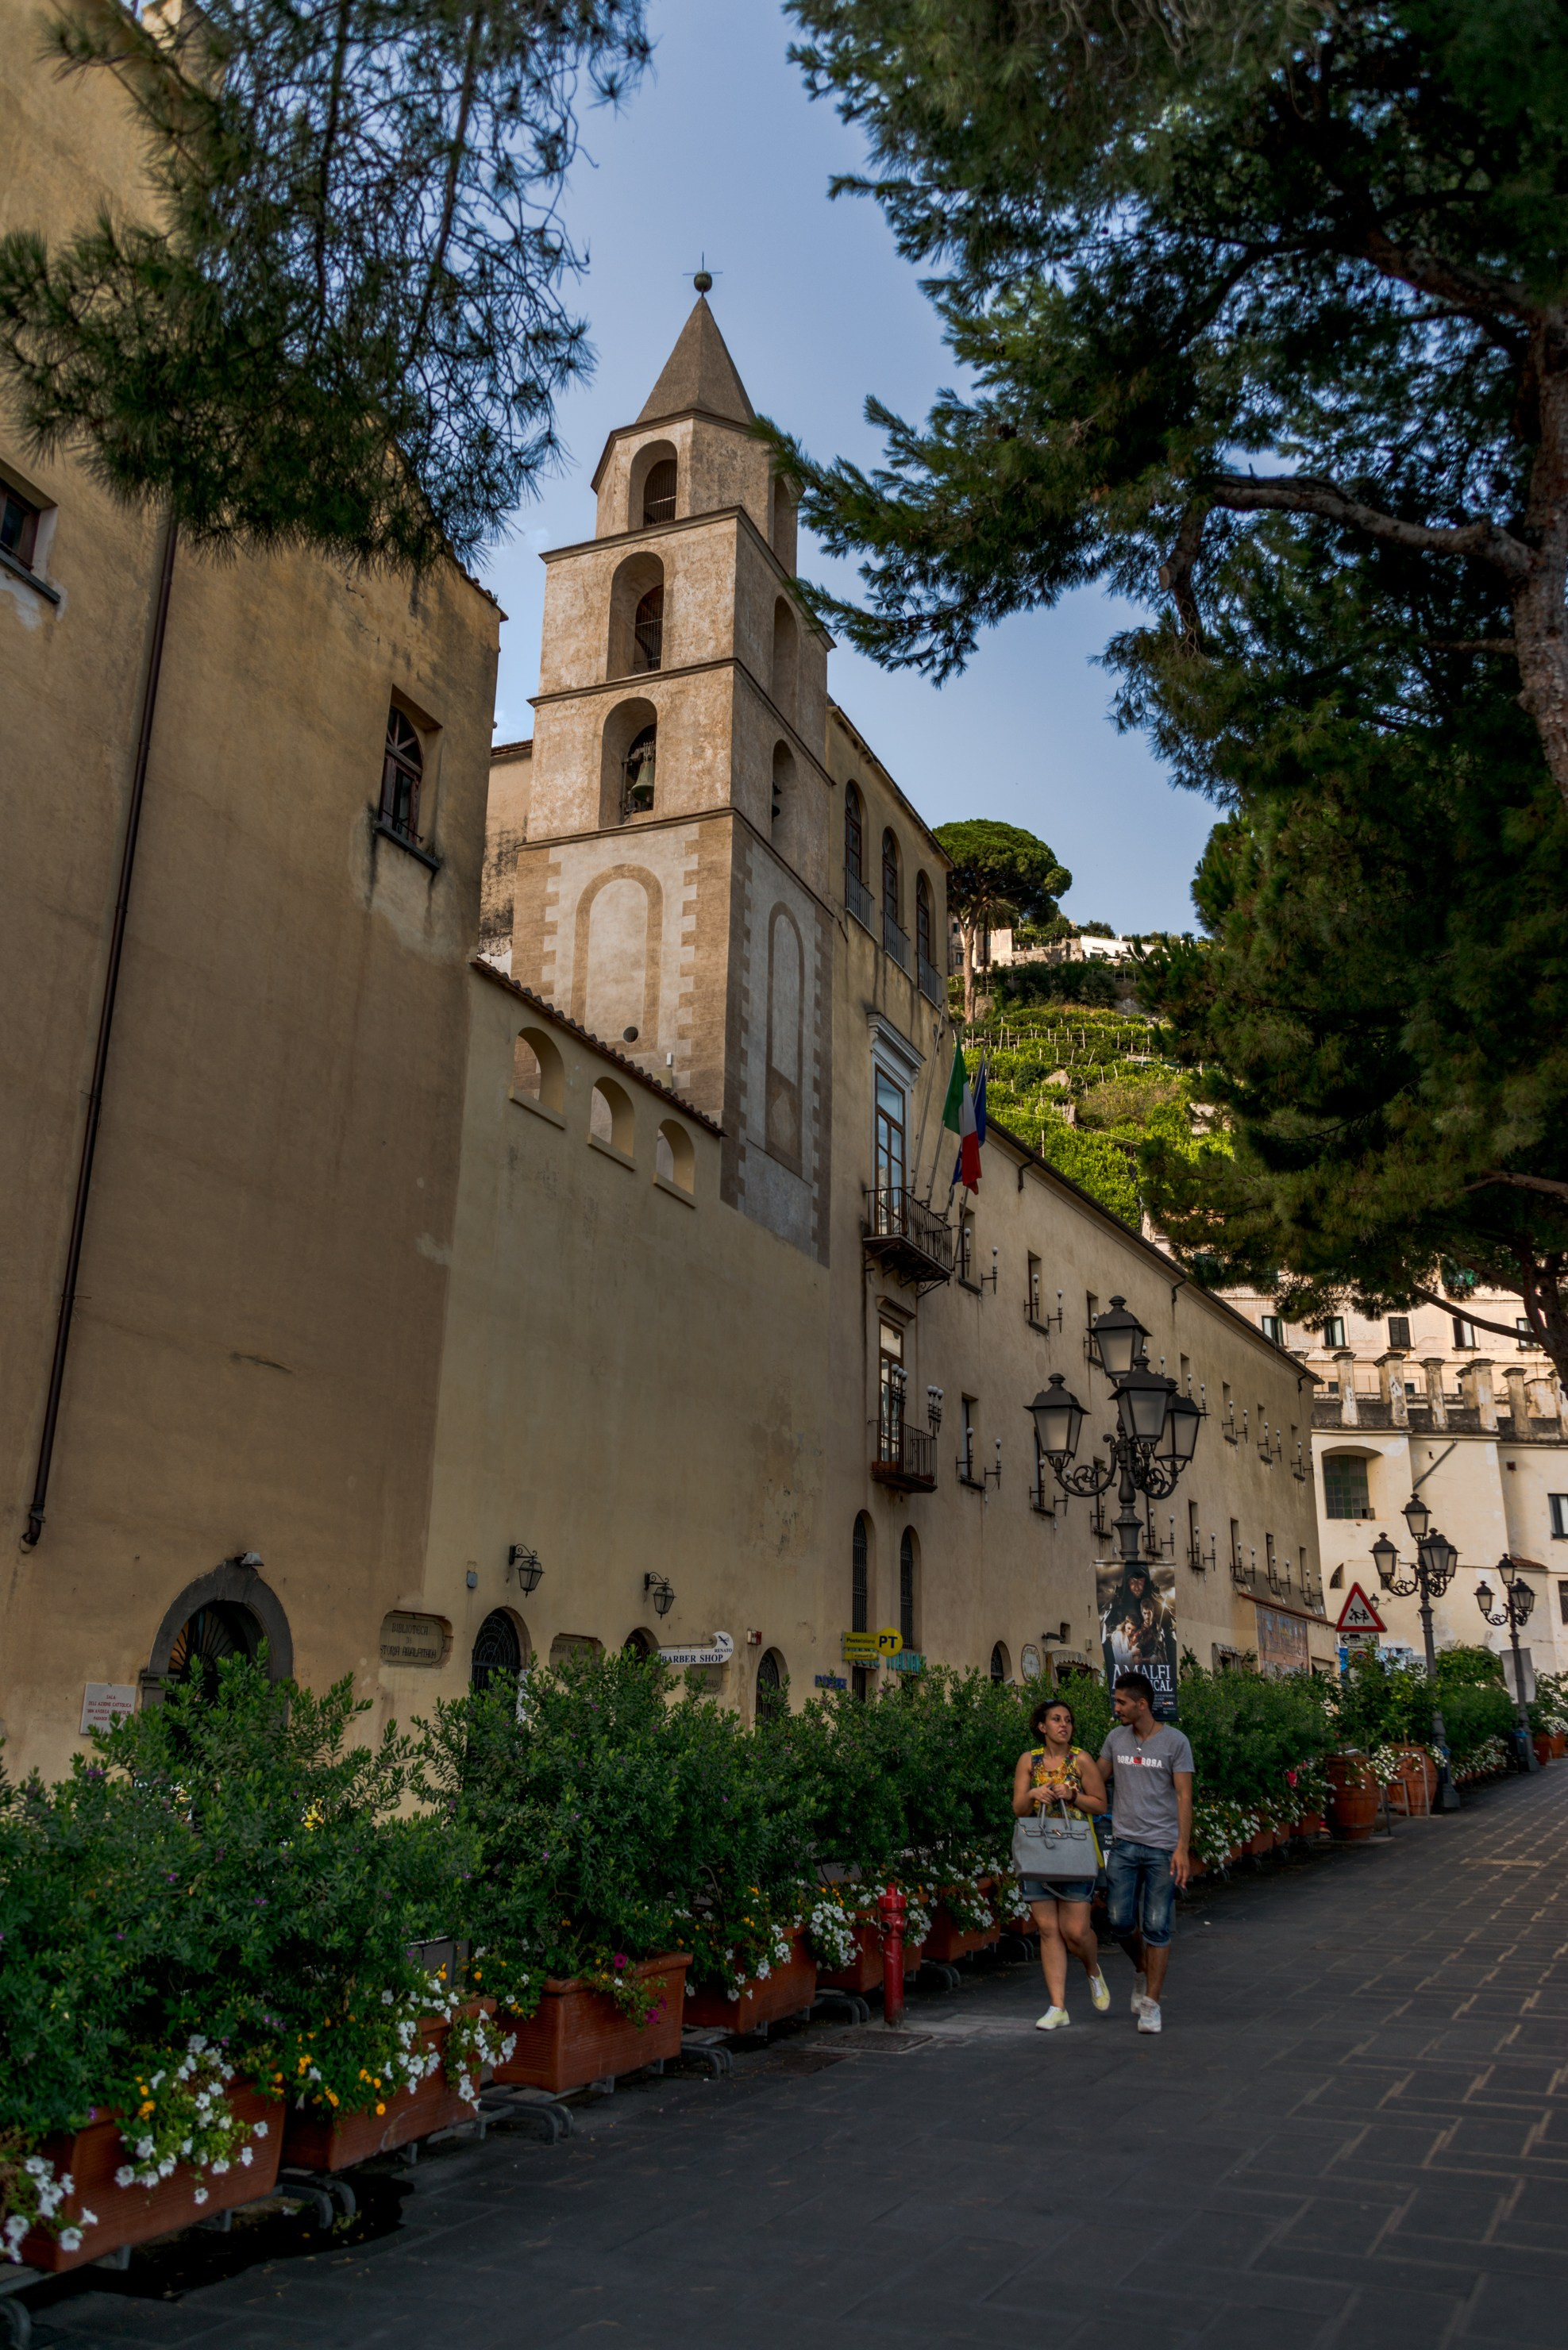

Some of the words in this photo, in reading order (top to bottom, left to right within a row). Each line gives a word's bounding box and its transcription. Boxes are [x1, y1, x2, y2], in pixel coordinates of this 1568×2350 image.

[392, 1624, 428, 1635] BIBLIOTECA
[879, 1635, 898, 1648] PT
[380, 1645, 400, 1657] STORIA
[661, 1655, 696, 1663] BARBER
[699, 1654, 723, 1663] SHOP
[1117, 1755, 1135, 1765] BORA
[1142, 1757, 1163, 1768] BORA
